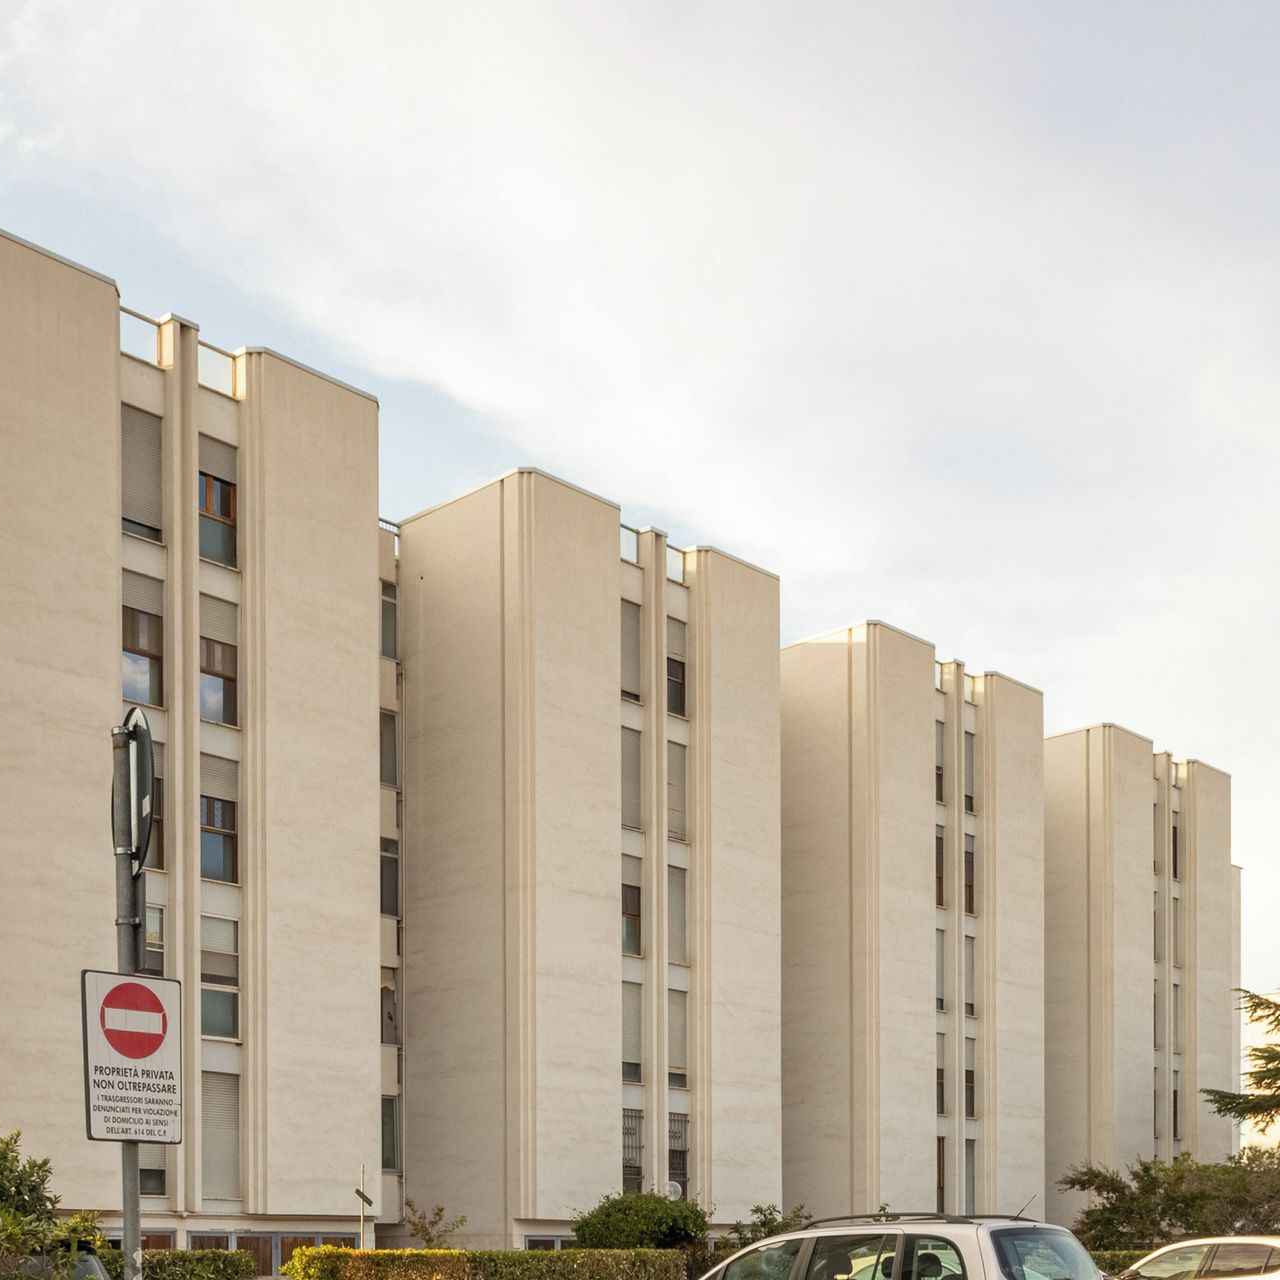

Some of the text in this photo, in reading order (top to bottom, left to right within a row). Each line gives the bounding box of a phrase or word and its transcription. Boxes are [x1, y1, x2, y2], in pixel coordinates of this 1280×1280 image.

[94, 1065, 174, 1080] PROPRIETÀ PRIVATA
[93, 1079, 177, 1094] NON OLTREPASSARE
[101, 1095, 143, 1104] TRASGRESSORI
[144, 1098, 174, 1106] SARANNO
[93, 1105, 130, 1114] DENUNCIATI
[143, 1108, 178, 1117] VIOLAZIONE
[112, 1117, 144, 1125] DOMICILIO
[106, 1127, 133, 1135] DELL'ART.
